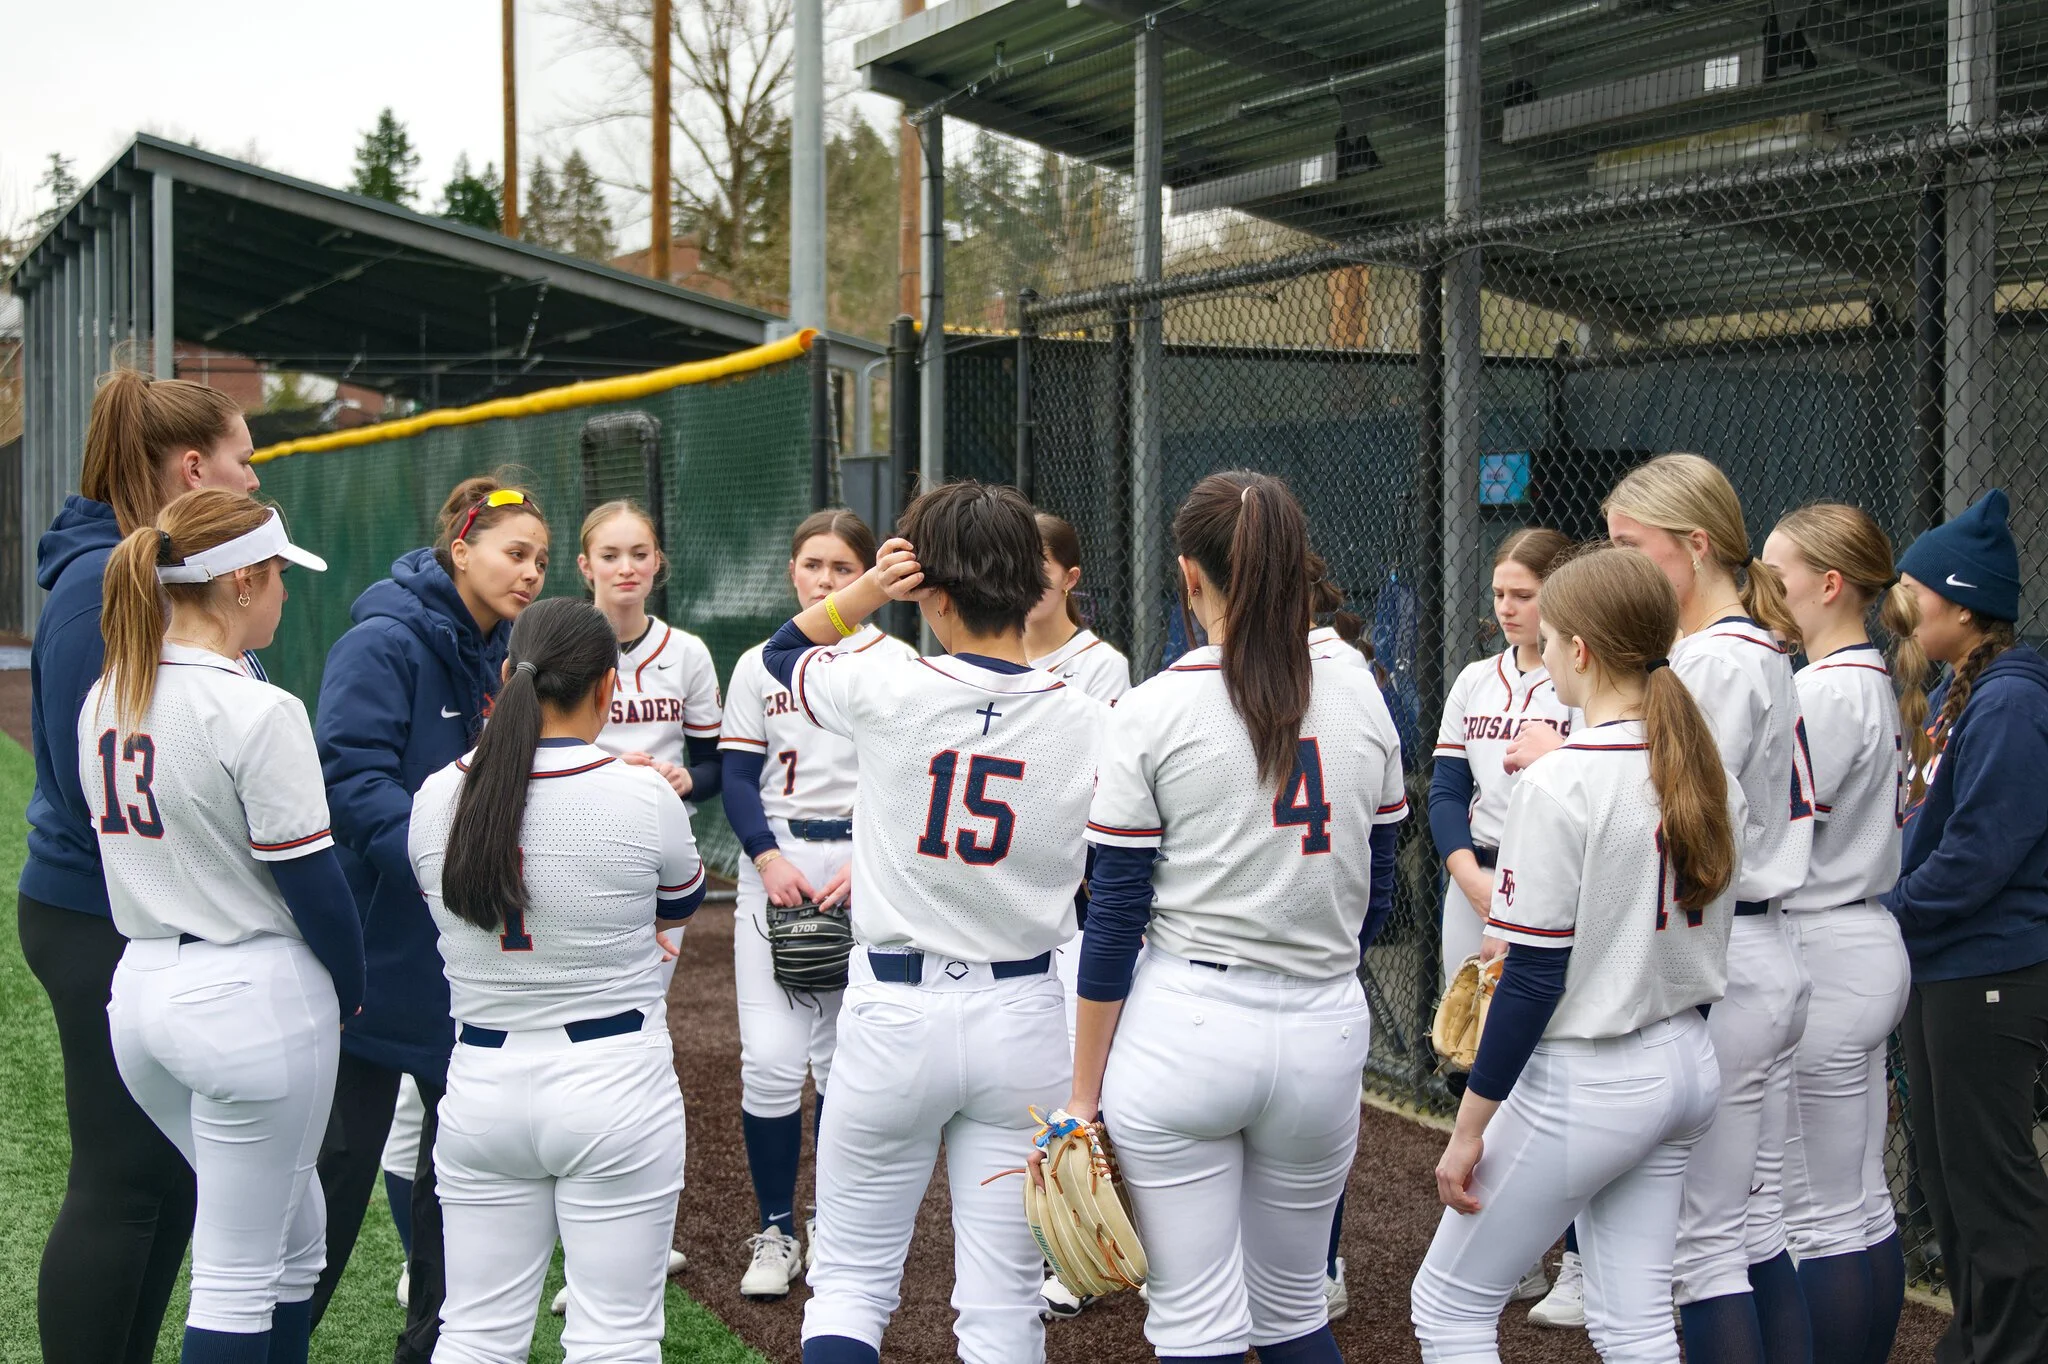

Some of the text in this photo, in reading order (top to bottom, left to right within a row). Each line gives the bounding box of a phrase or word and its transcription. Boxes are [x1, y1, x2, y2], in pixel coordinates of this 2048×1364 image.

[610, 698, 684, 724] SADER
[98, 728, 165, 840] 13
[778, 750, 798, 797] 7
[917, 749, 1026, 867] 15
[1272, 736, 1331, 856] 4
[790, 923, 818, 934] A700
